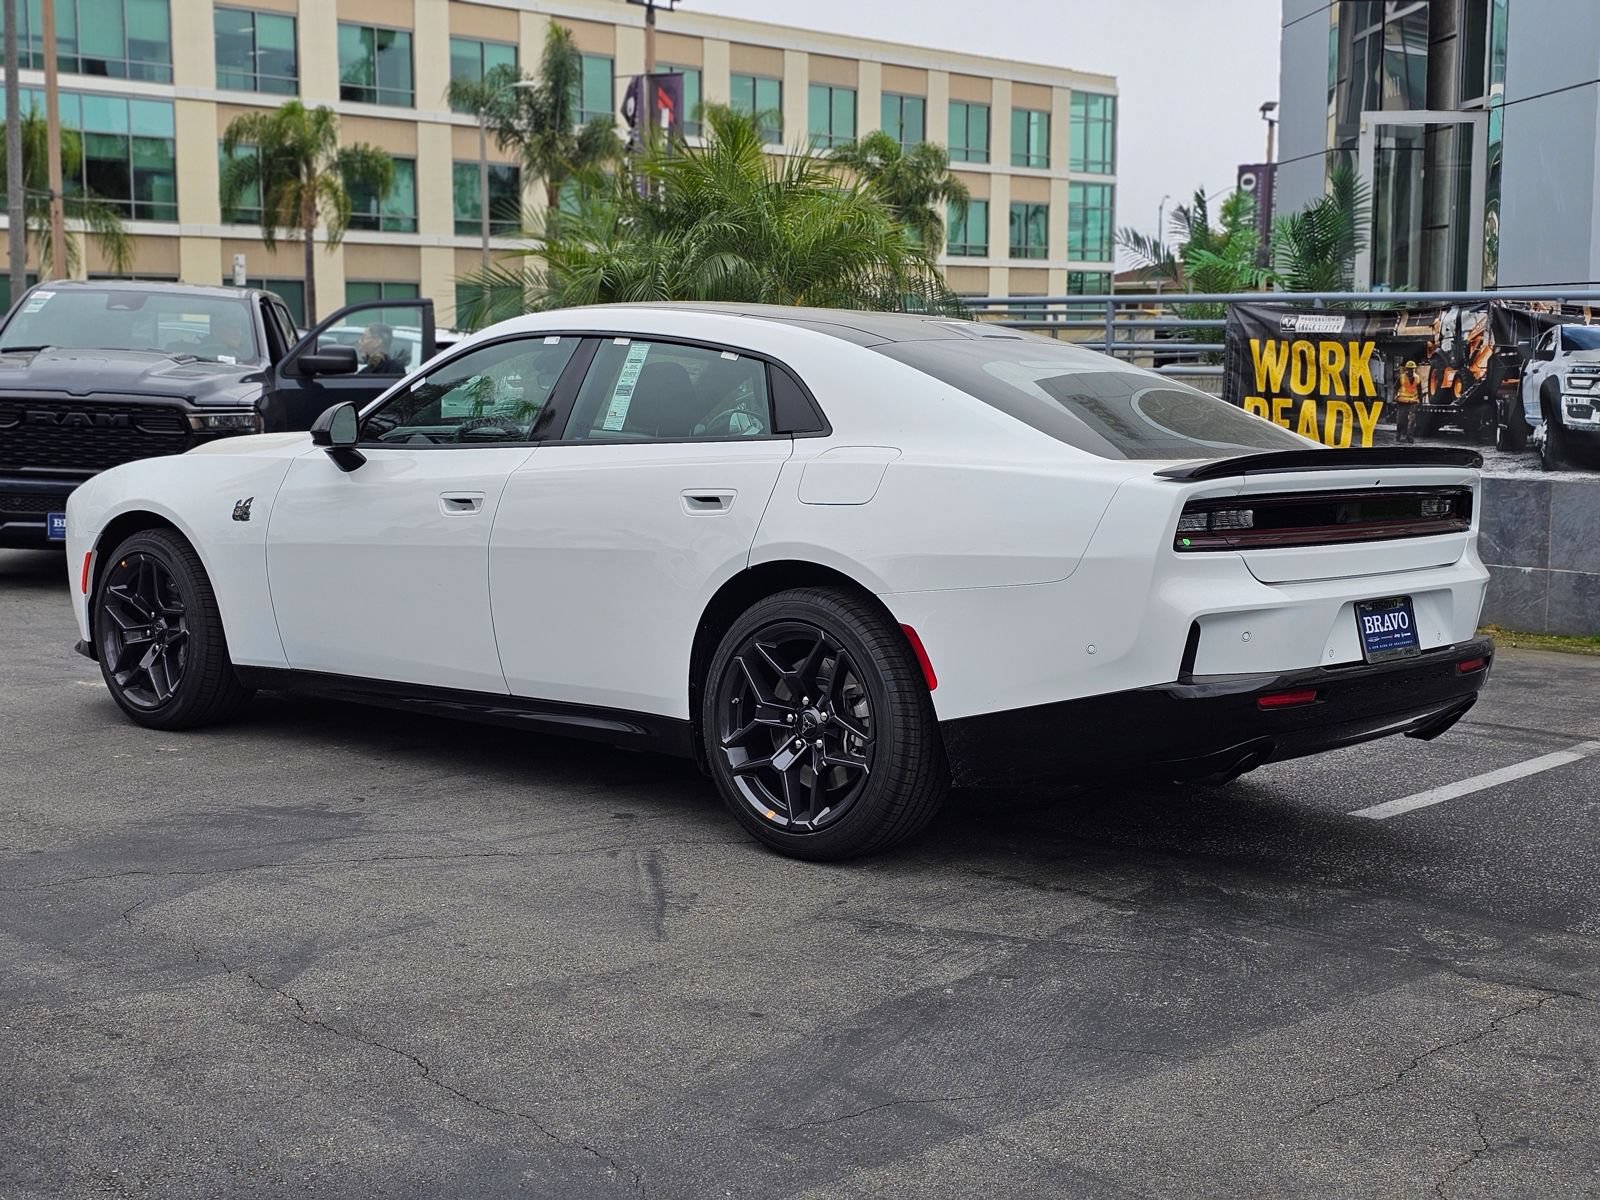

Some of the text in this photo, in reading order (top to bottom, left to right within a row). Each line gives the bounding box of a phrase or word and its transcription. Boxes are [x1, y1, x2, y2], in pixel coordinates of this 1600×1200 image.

[1249, 339, 1377, 396] WORK
[26, 410, 129, 426] RAM
[1363, 611, 1409, 634] BRAVO
